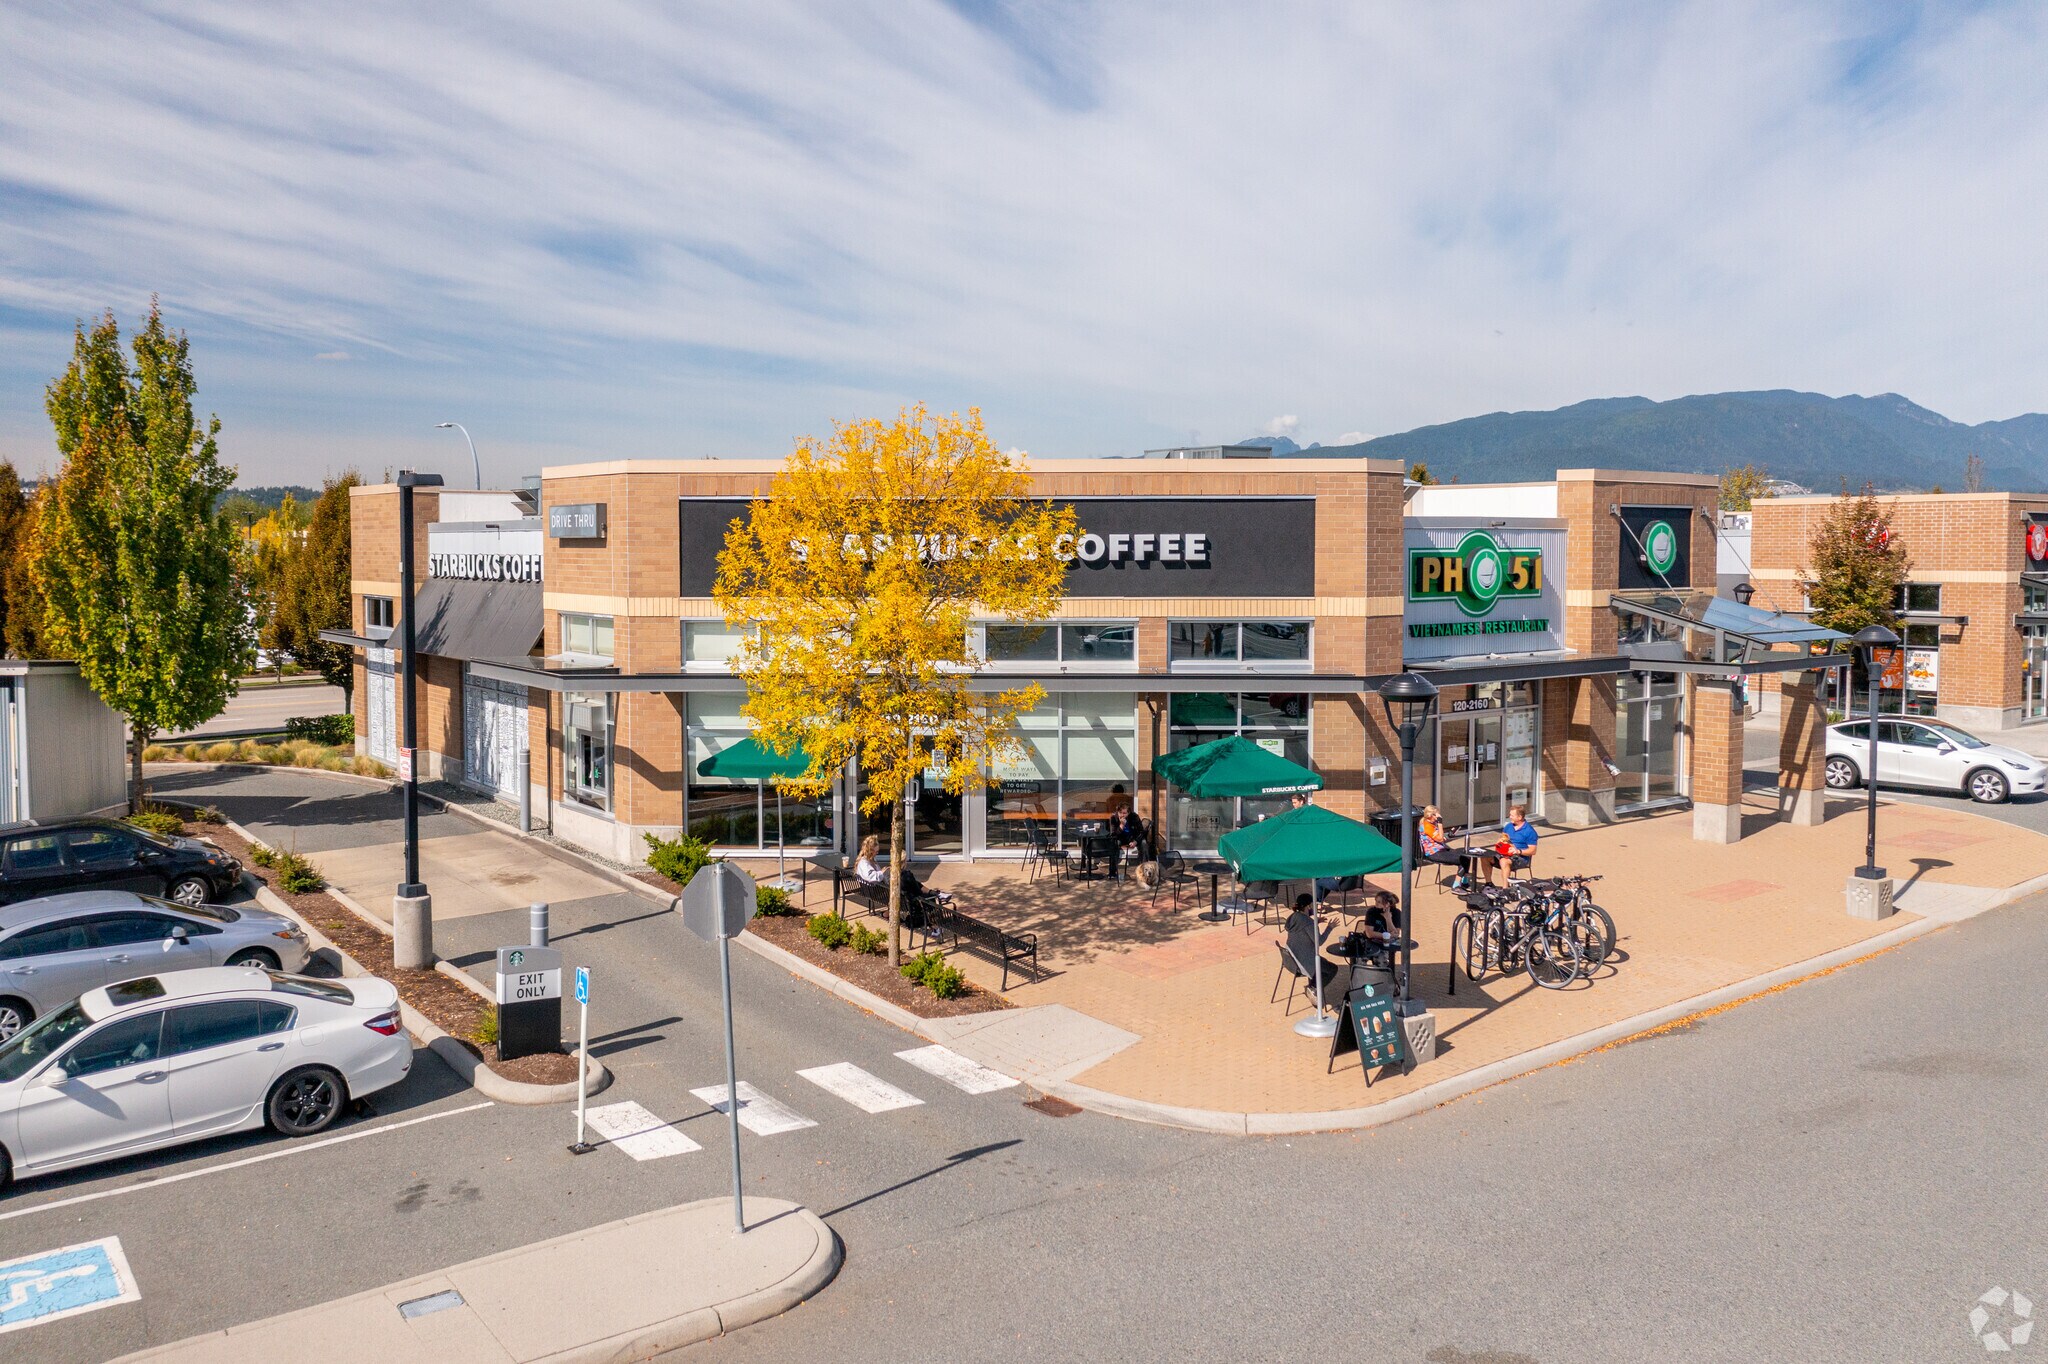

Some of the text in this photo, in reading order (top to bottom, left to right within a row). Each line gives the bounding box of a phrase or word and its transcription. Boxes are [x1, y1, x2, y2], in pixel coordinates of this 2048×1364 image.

[551, 513, 595, 528] DRIVE THRU
[789, 533, 1206, 562] SARBUCS COFFEE
[429, 553, 501, 580] STARBUCKS
[1513, 556, 1542, 590] 51
[1412, 619, 1550, 638] VIETNAMESE RESTAURANT
[1454, 699, 1488, 711] 120-2160
[519, 973, 544, 985] EXIT
[516, 986, 546, 998] ONLY
